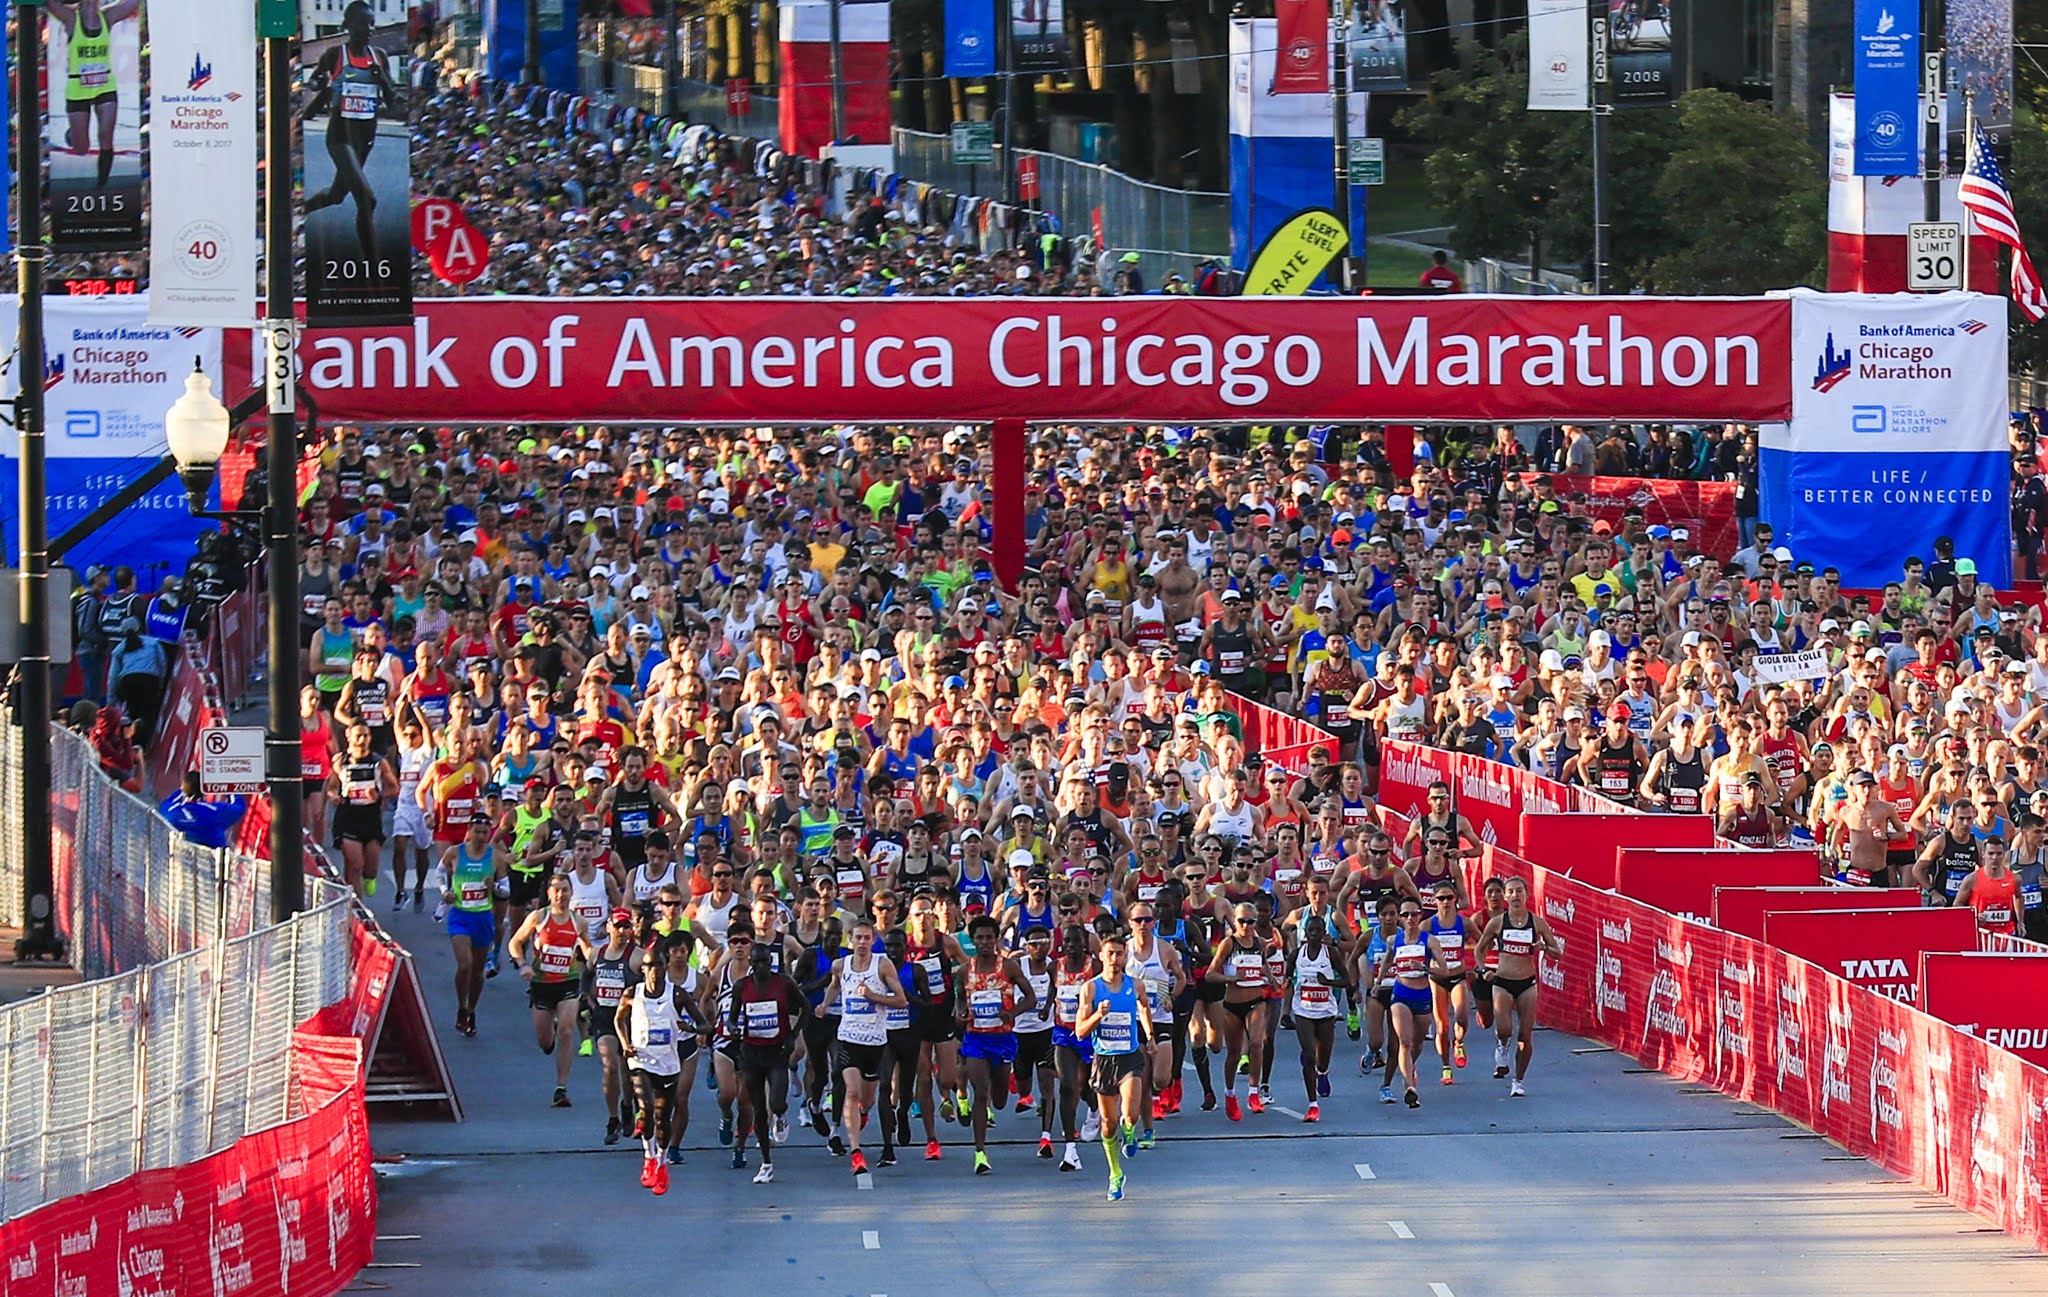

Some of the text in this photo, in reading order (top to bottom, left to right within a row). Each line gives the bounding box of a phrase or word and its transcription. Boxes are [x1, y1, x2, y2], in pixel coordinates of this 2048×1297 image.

[961, 36, 980, 47] 40
[1869, 41, 1901, 52] Chicago
[1022, 43, 1056, 54] 2015
[1292, 47, 1310, 59] 40
[1593, 20, 1605, 80] C120
[1866, 50, 1904, 58] Marathon
[1361, 56, 1397, 67] 2014
[1551, 62, 1567, 73] 40
[1623, 71, 1662, 83] 2008
[1926, 56, 1939, 120] C110
[161, 94, 181, 103] Bank
[191, 94, 222, 103] America
[176, 106, 223, 119] Chicago
[170, 120, 229, 130] Marathon
[1876, 127, 1895, 136] 40
[173, 140, 203, 148] October
[67, 195, 124, 213] 2015
[1306, 217, 1340, 240] ALERT
[1913, 228, 1956, 240] SPEED
[1300, 229, 1336, 253] LEVEL
[188, 240, 217, 260] 40
[444, 227, 477, 269] A
[1918, 242, 1951, 253] LIMIT
[326, 260, 391, 280] 2016
[1916, 256, 1955, 280] 30
[72, 329, 170, 341] Bank of America
[1859, 324, 1955, 337] Bank of America
[72, 347, 149, 368] Chicago
[1859, 343, 1933, 363] Chicago
[489, 315, 580, 388] of
[607, 317, 954, 388] America
[988, 317, 1322, 406] Chicago
[1357, 315, 1760, 387] Marathon
[72, 367, 167, 384] Marathon
[1859, 364, 1952, 380] Marathon
[1892, 418, 1947, 426] MARATHON
[1892, 426, 1931, 434] MAJORS
[85, 475, 126, 490] LIFE
[1871, 470, 1928, 485] LIFE /
[1804, 488, 1993, 504] BETTER CONNECTED
[151, 613, 179, 627] VIDEO
[1758, 650, 1822, 666] GIOIA DEL COLLE
[1773, 749, 1795, 760] REATER
[219, 758, 251, 766] STOPPING
[218, 766, 251, 774] STANDING
[1386, 749, 1408, 783] Bank
[1414, 760, 1442, 790] America
[206, 782, 260, 792] TOW ZONE
[1462, 765, 1481, 799] Bank
[1486, 769, 1511, 808] America
[1609, 780, 1622, 788] 165
[1680, 796, 1695, 804] 1093
[1955, 852, 1970, 860] new
[1990, 913, 2005, 922] 448
[543, 955, 569, 966] A 1271
[597, 969, 624, 979] CANADA
[1840, 958, 1909, 979] TATA
[1656, 969, 1682, 1008] Chicago
[975, 1006, 999, 1017] LILESA
[1651, 1001, 1687, 1037] Marathon
[1101, 1029, 1130, 1038] ESTRADA
[129, 1242, 164, 1282] Chicago
